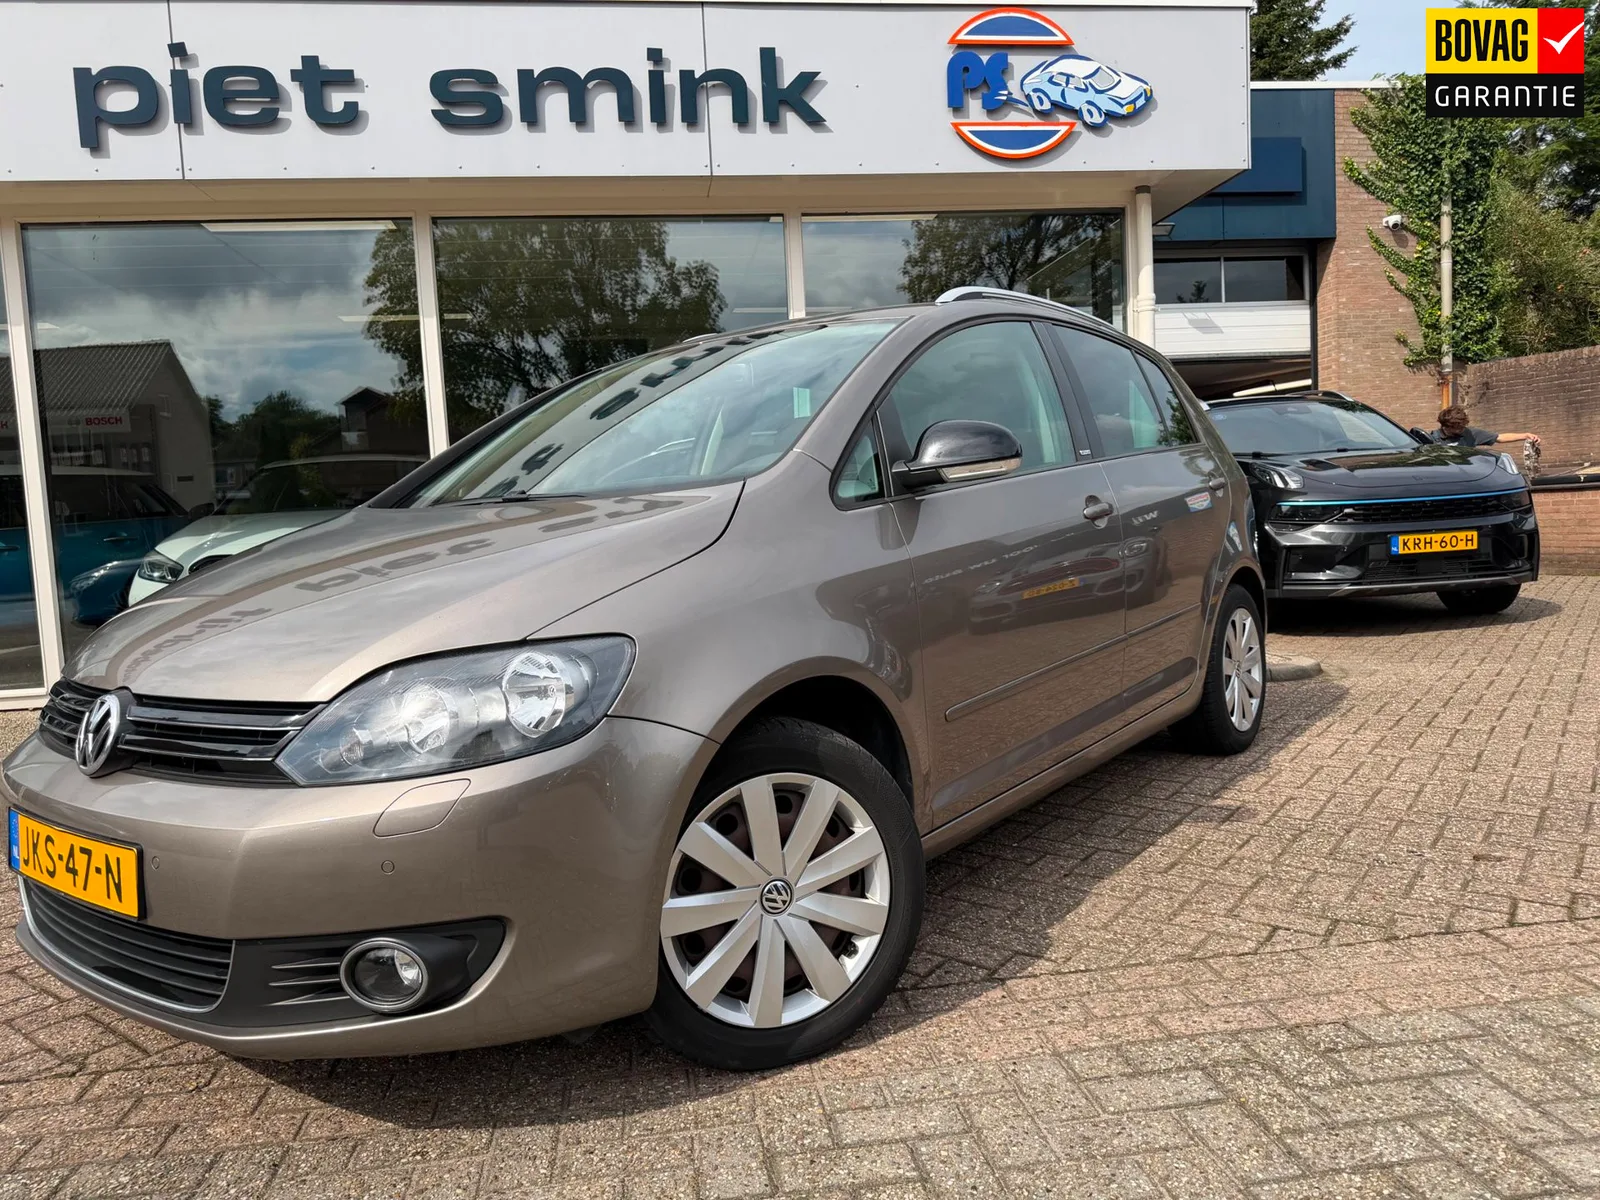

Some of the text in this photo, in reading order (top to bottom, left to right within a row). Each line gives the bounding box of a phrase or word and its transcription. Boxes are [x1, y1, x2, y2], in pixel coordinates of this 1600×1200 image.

[72, 42, 828, 149] piet smink
[84, 416, 123, 426] BOSCH
[1402, 533, 1475, 551] KRH-60-H
[23, 826, 123, 904] JKS-47-N
